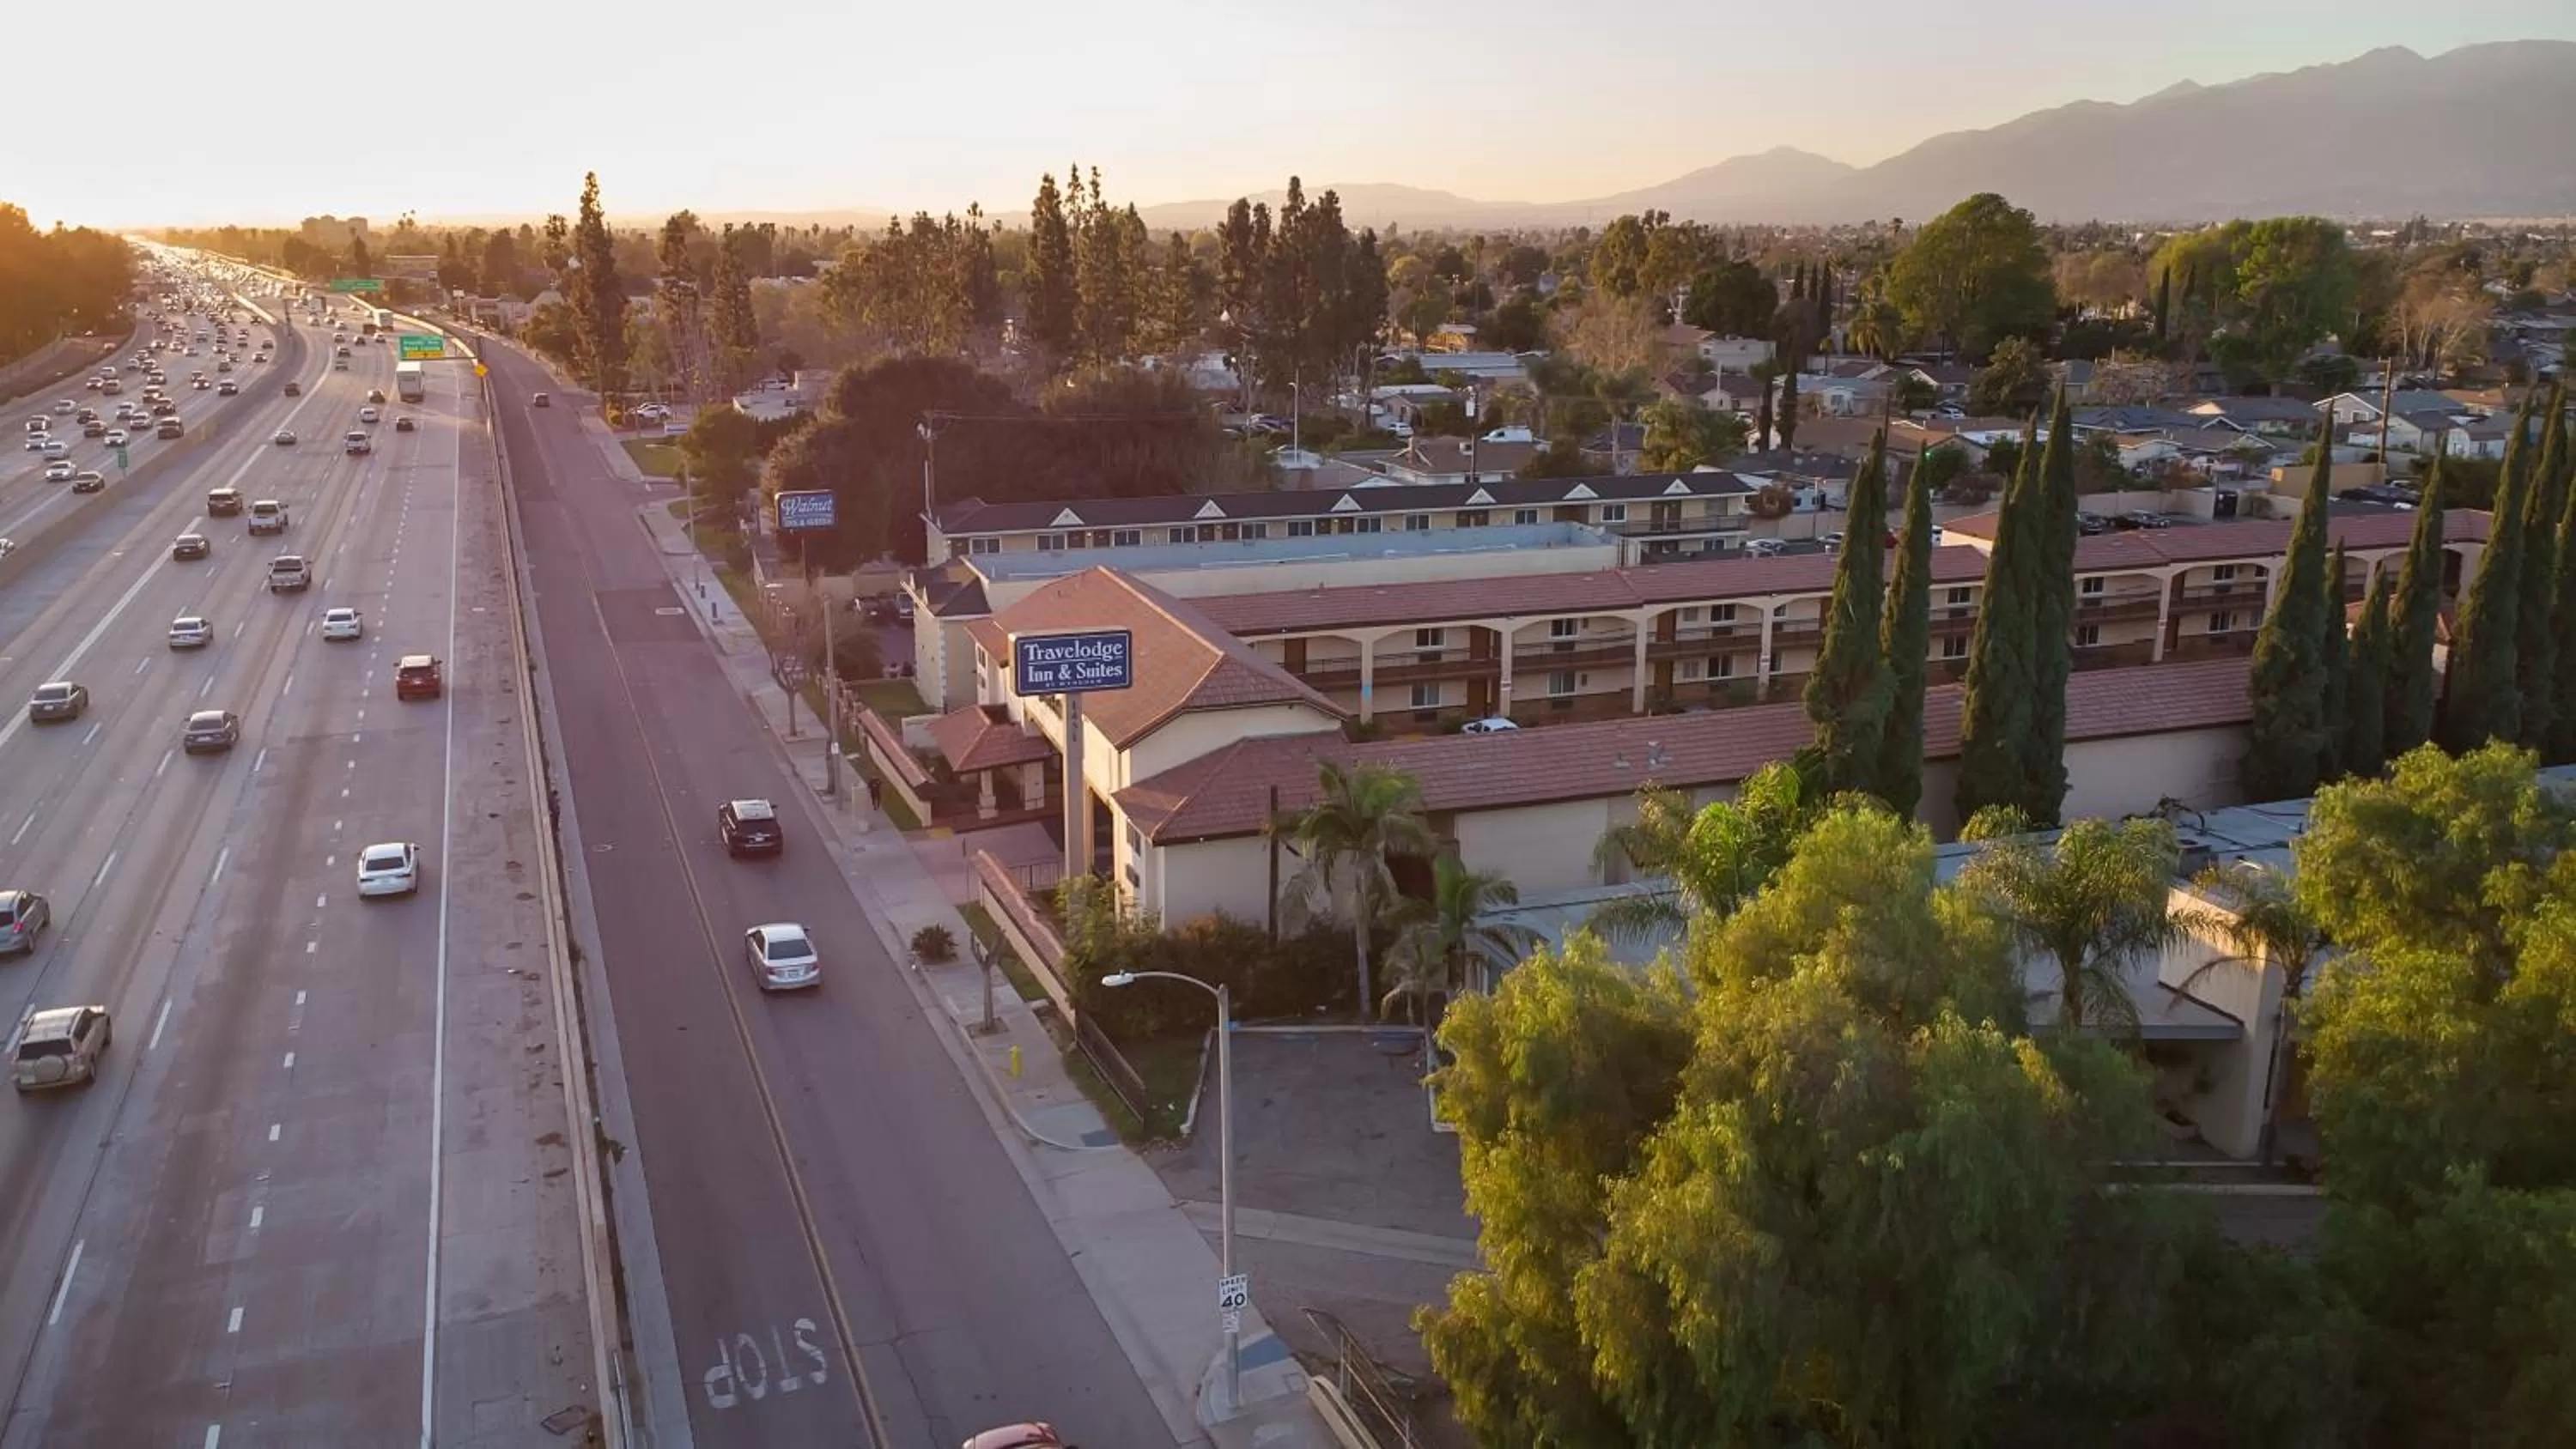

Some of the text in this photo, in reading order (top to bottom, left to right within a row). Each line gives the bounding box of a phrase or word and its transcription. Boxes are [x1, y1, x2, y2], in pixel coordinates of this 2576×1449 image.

[1024, 640, 1123, 662] Travelodge
[1028, 662, 1122, 682] Inn & Suites
[1222, 1293, 1246, 1307] 40
[703, 1317, 828, 1409] STOP
